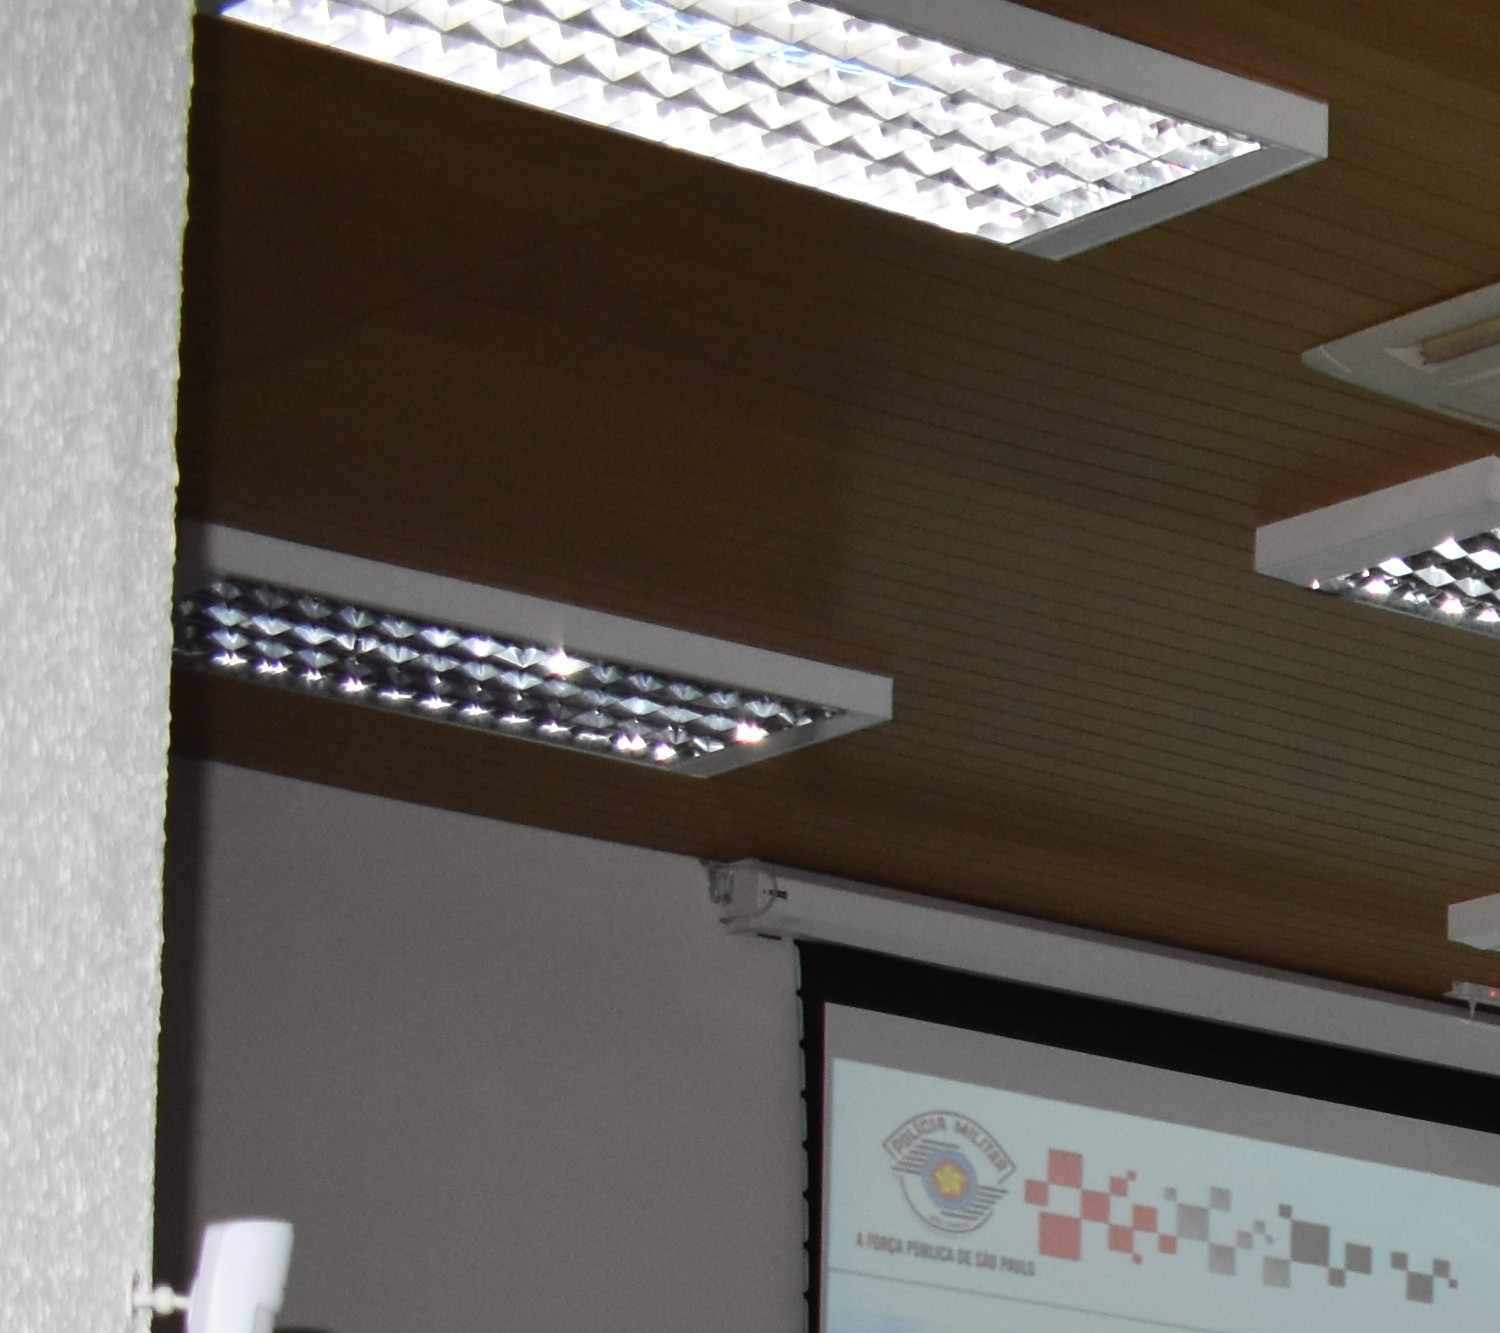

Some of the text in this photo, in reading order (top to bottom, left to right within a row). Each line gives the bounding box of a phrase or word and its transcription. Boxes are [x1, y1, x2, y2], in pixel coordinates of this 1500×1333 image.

[954, 1119, 1008, 1172] MILITAR
[956, 1249, 971, 1266] DE
[975, 1249, 997, 1270] SÃO
[1001, 1256, 1036, 1277] PAULO
